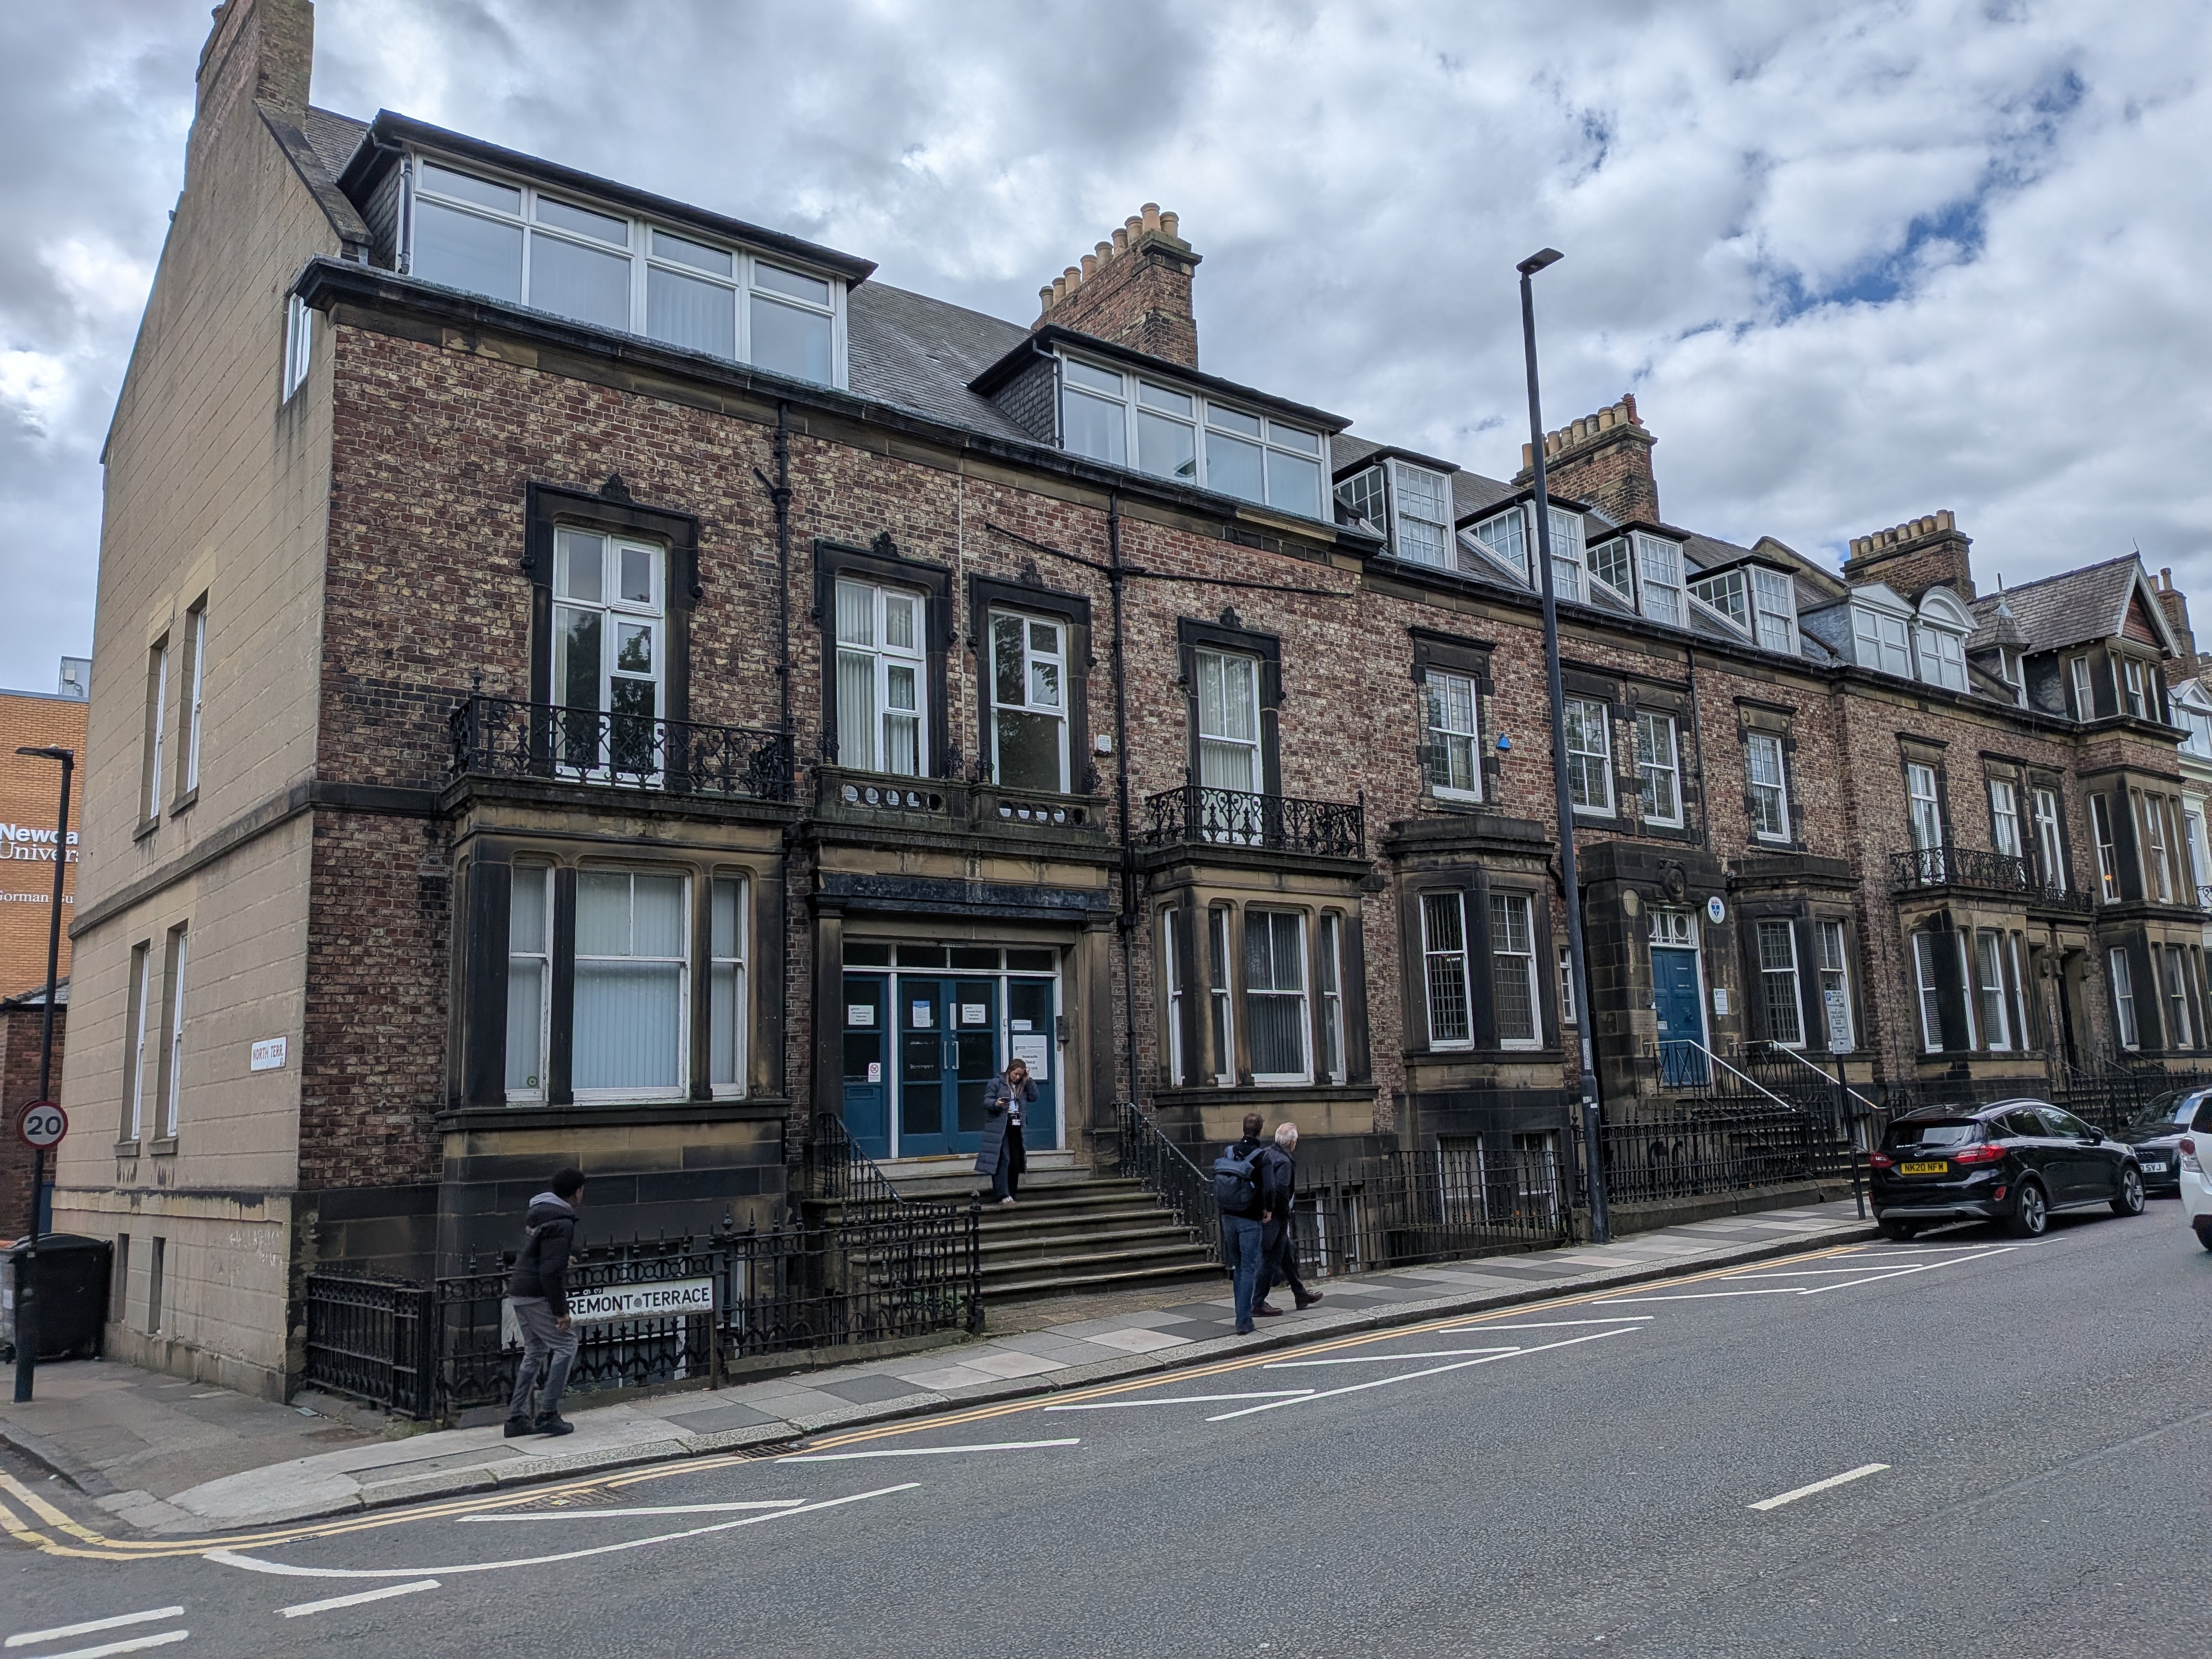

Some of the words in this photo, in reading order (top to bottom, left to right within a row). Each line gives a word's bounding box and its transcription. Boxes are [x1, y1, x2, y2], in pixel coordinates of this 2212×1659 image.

[253, 1046, 269, 1061] NORTH
[27, 1116, 61, 1135] 20
[1905, 1164, 1926, 1172] NK20
[642, 1287, 710, 1308] TERRACE
